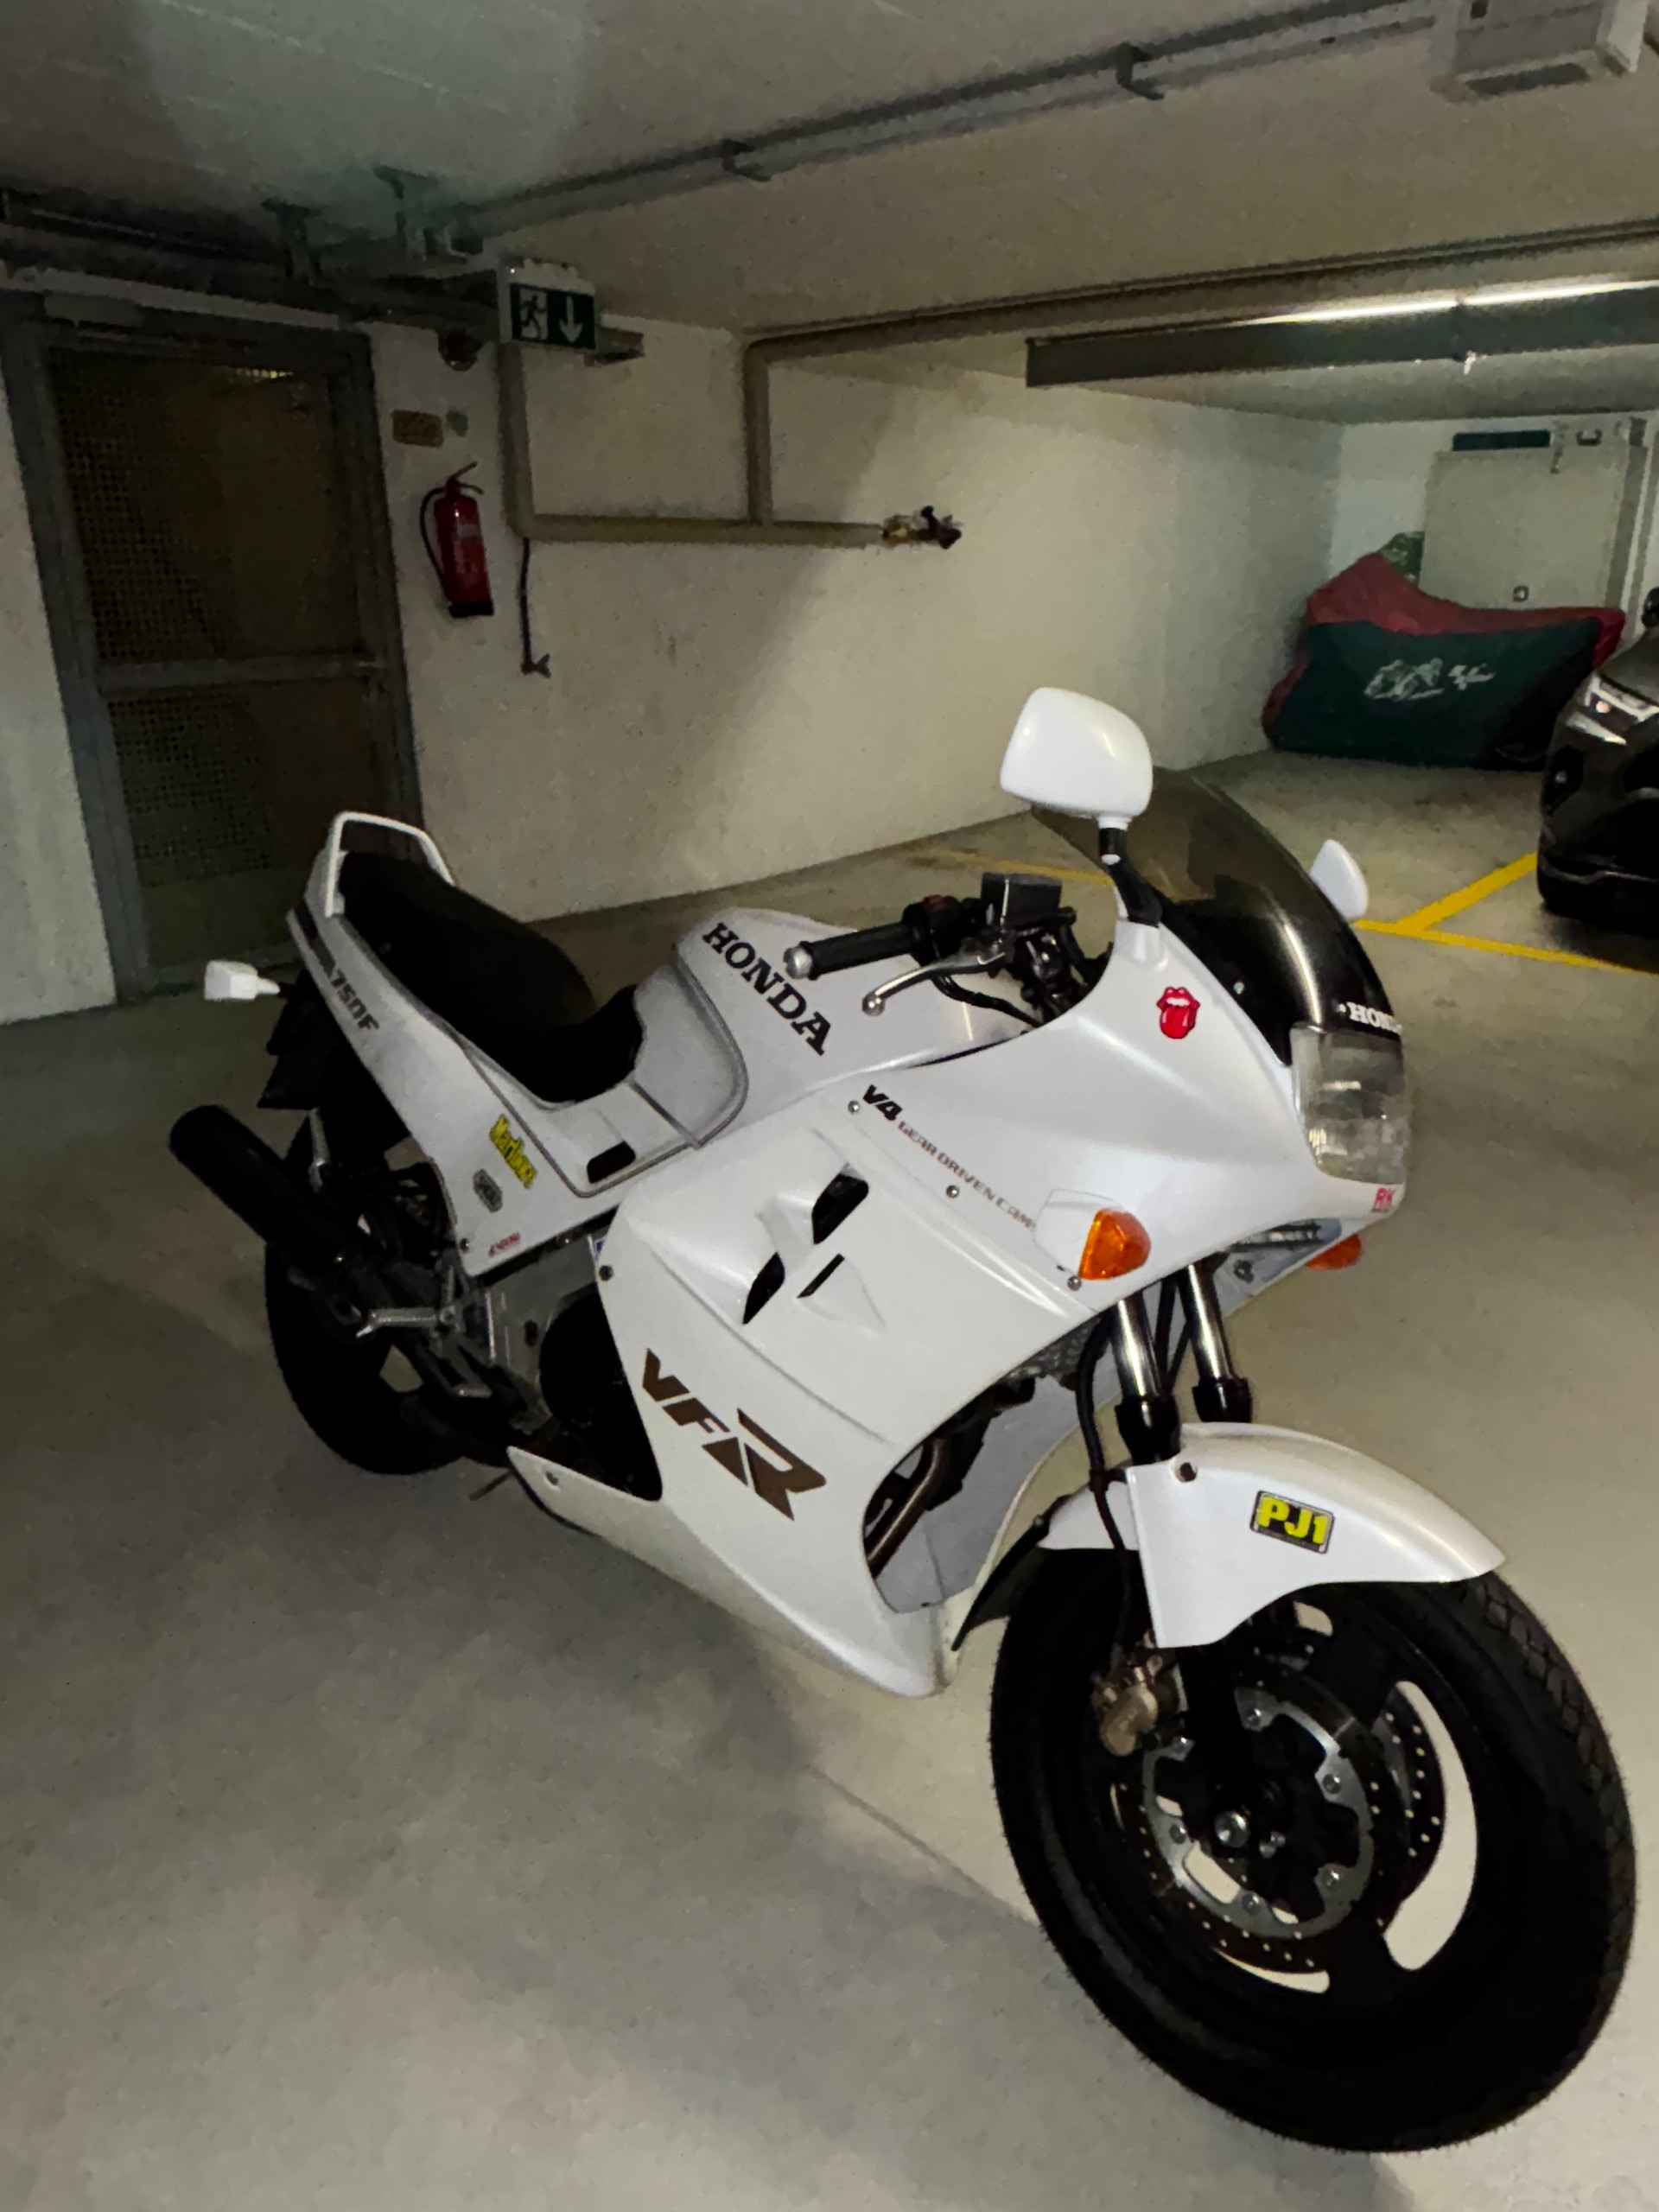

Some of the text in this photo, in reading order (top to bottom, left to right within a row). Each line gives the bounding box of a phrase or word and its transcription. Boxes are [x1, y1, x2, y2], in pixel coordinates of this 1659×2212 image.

[702, 922, 831, 1056] HONDA
[862, 1084, 903, 1121] V4
[898, 1121, 937, 1156] GEAR
[938, 1153, 995, 1200] DRIVEN
[642, 1347, 826, 1521] VFR
[1258, 1496, 1328, 1544] PJ1
